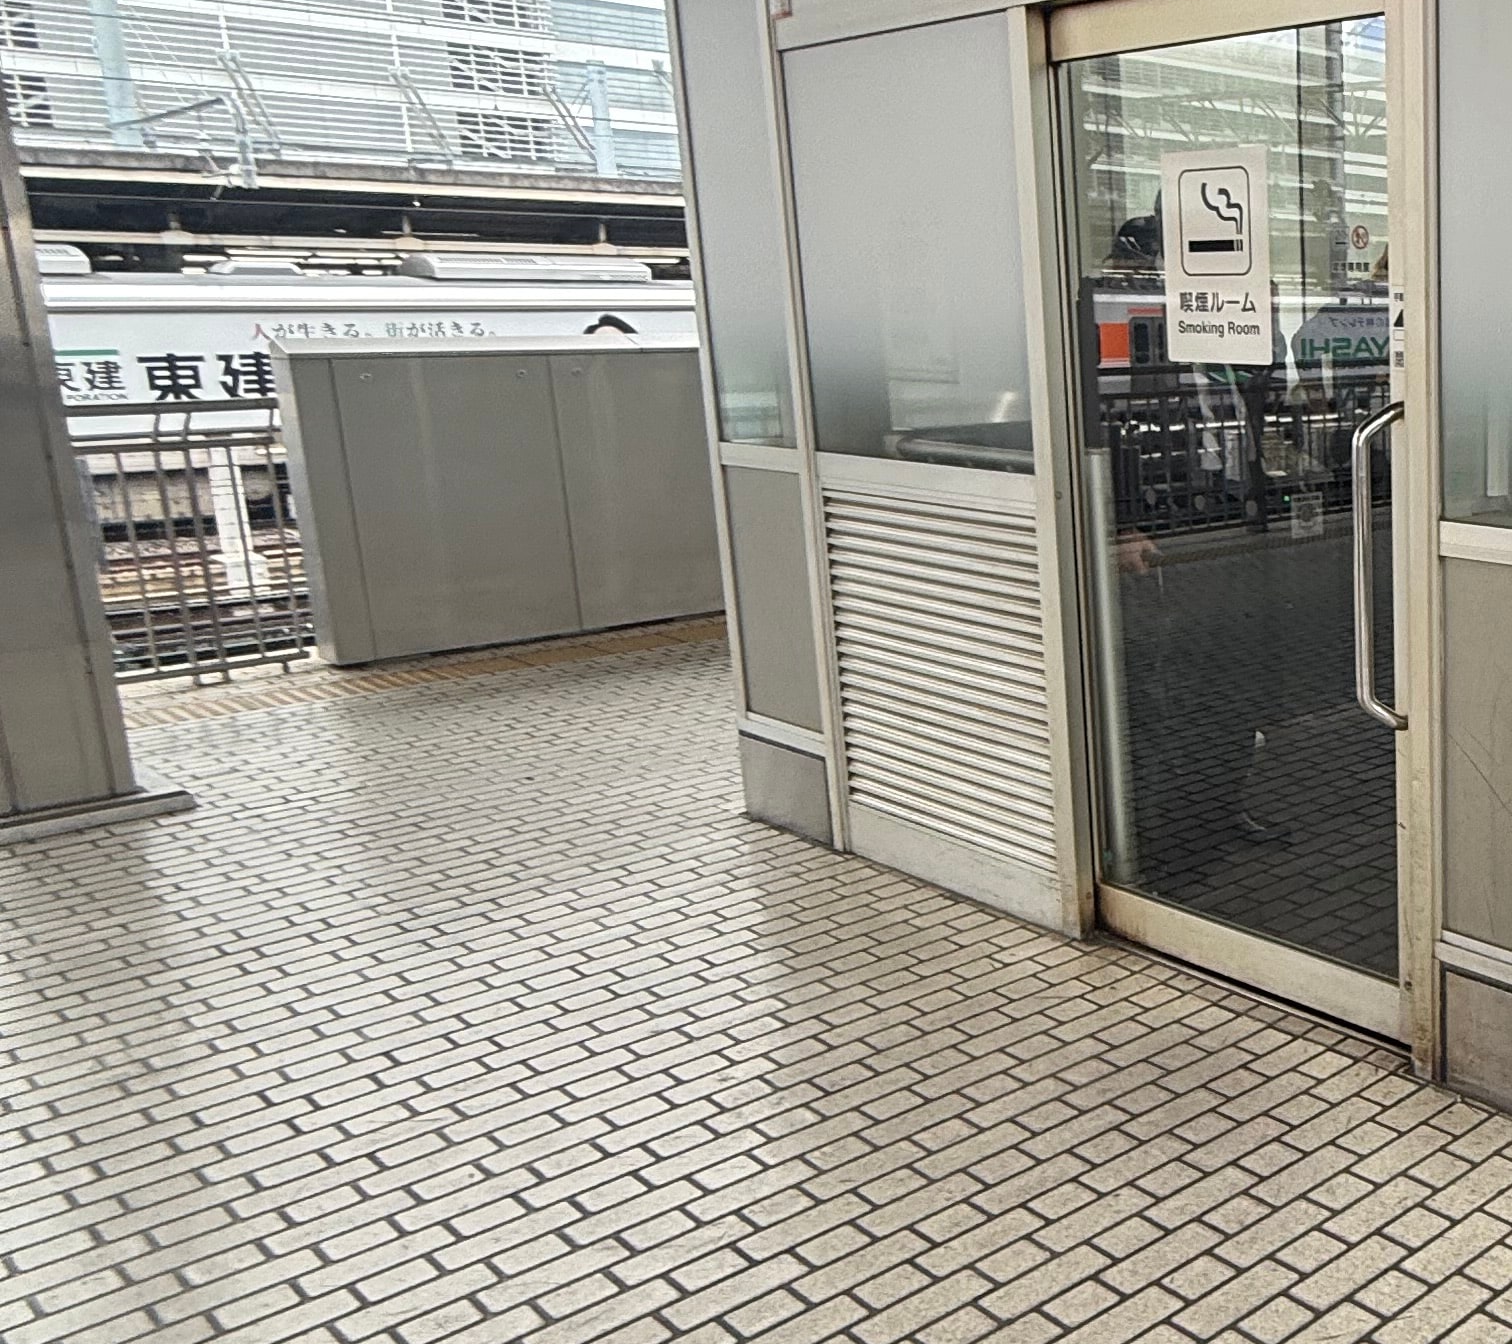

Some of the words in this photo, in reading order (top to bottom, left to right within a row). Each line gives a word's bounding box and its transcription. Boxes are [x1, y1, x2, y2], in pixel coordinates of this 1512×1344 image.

[1179, 292, 1256, 313] 喫煙ルーム
[1178, 320, 1225, 338] Smoking
[1228, 321, 1260, 335] Room
[137, 353, 278, 401] 東建
